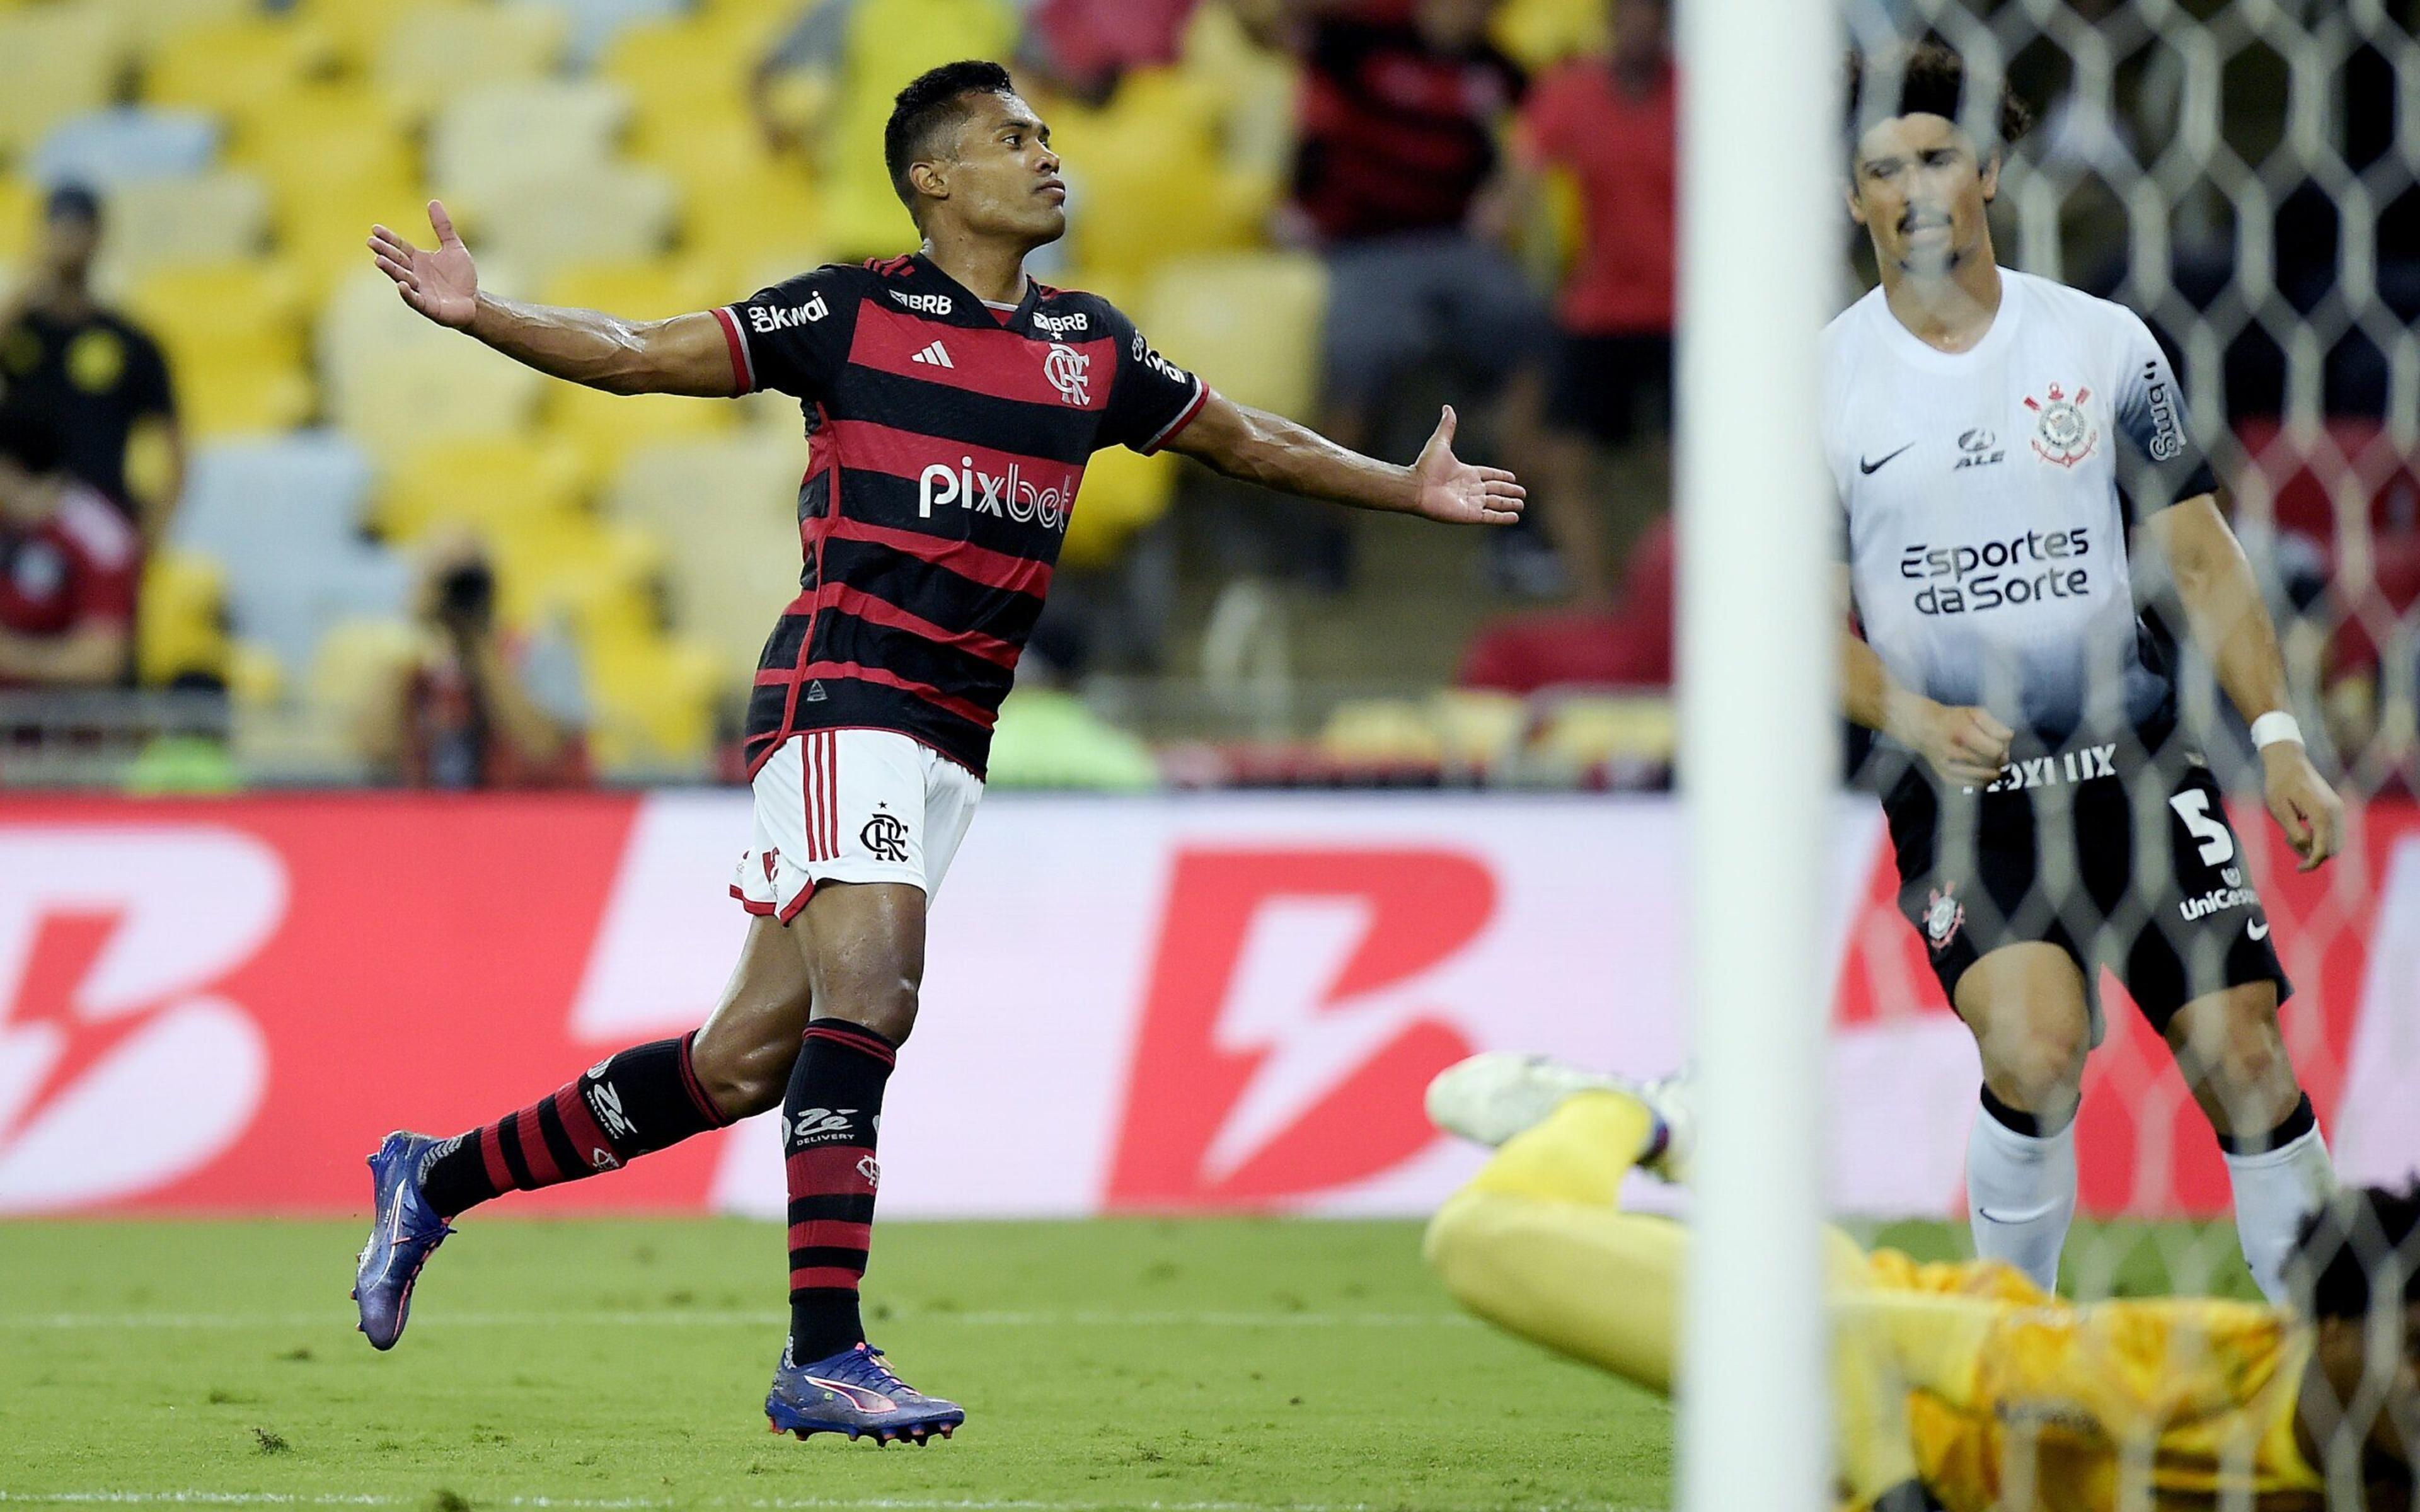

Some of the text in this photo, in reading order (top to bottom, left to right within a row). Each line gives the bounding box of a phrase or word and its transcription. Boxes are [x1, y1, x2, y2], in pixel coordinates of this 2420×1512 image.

[769, 290, 829, 329] kwai
[909, 294, 952, 315] BRB
[1050, 312, 1088, 332] BRB
[1953, 450, 2005, 470] ALE
[919, 455, 1071, 534] pixbet
[1901, 528, 2089, 583] Esportes
[2169, 788, 2235, 867] 5
[796, 1133, 855, 1147] DELIVERY
